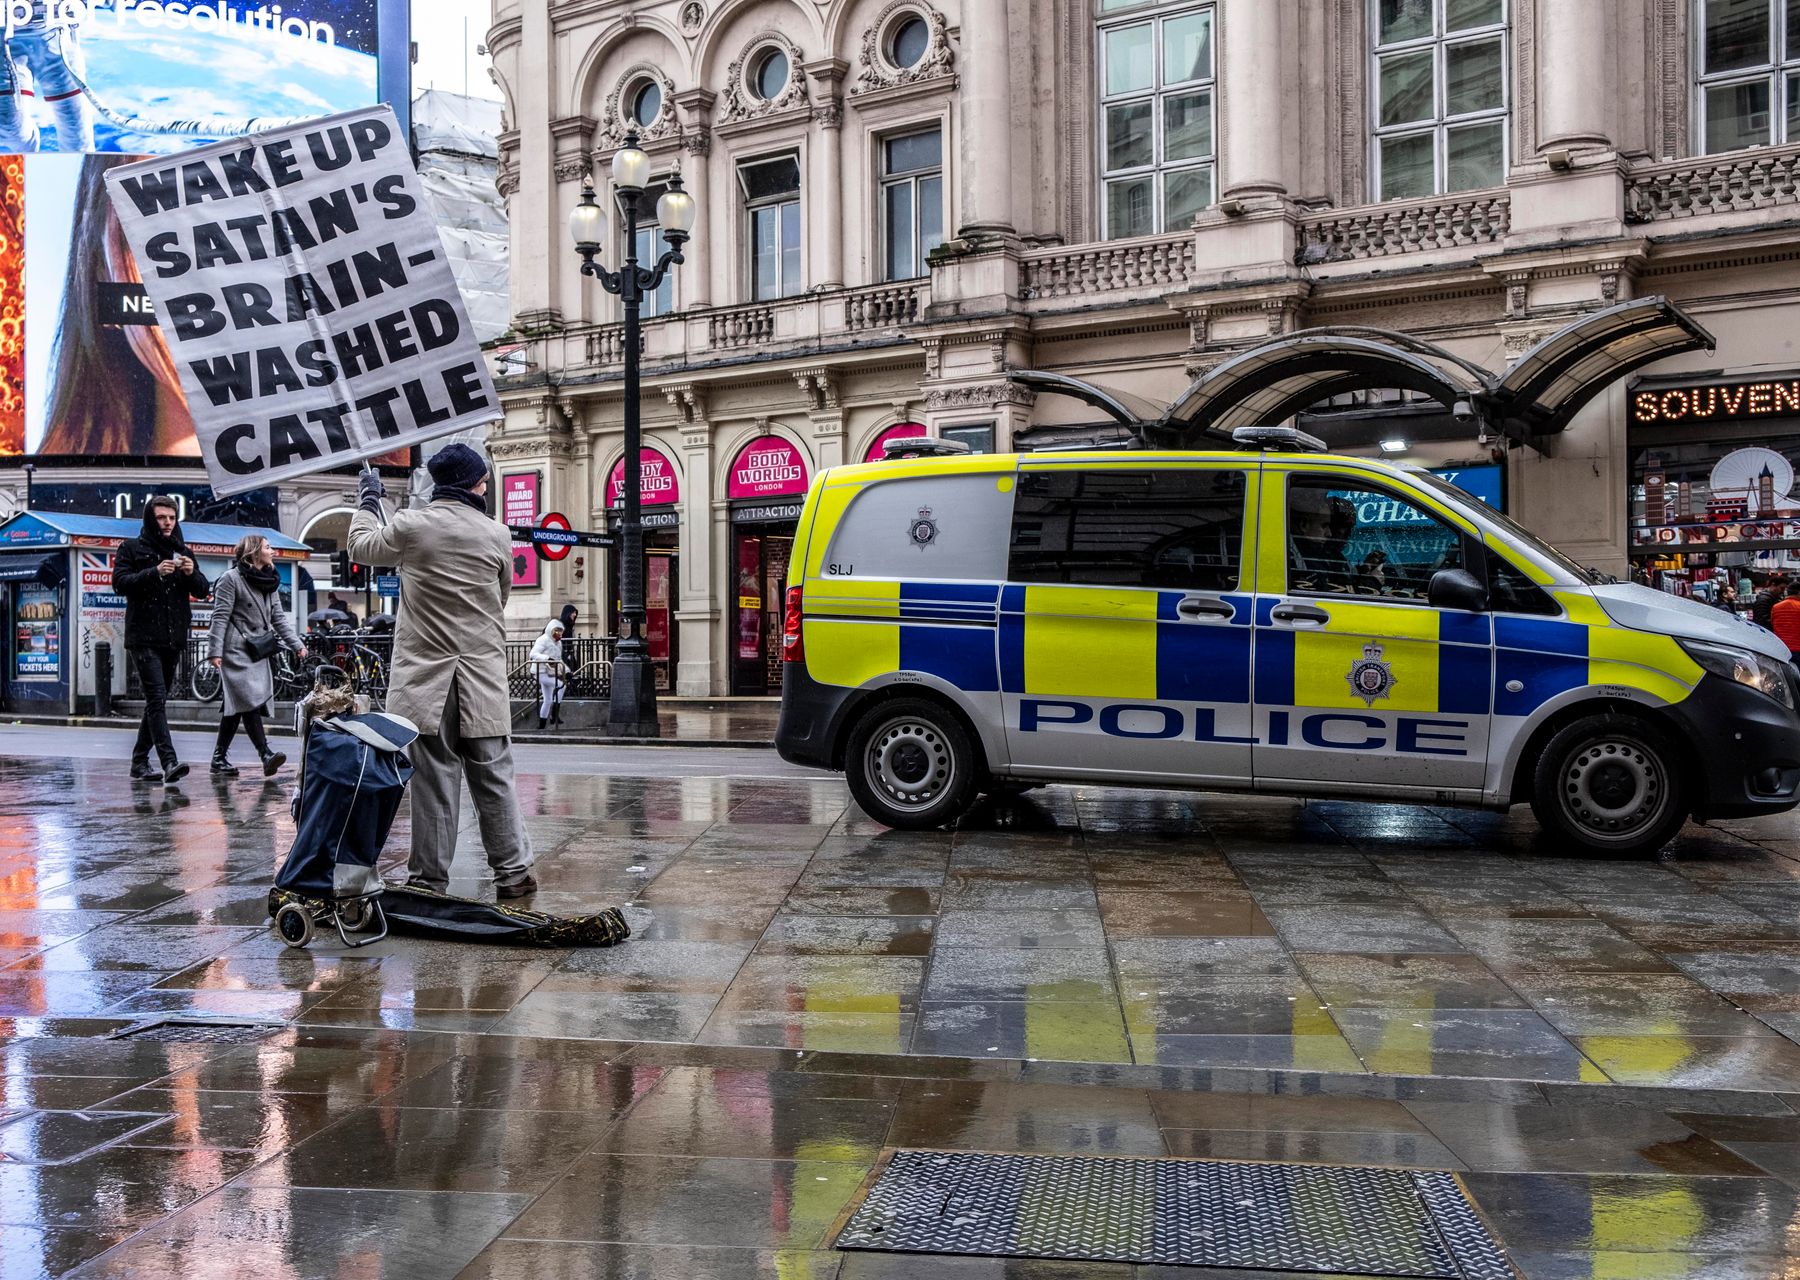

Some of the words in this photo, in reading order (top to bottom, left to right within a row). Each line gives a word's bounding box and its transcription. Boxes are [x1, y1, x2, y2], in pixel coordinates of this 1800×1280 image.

[117, 0, 334, 44] resolution
[120, 139, 303, 217] WAKE
[305, 119, 391, 172] UP
[145, 175, 416, 279] SATAN'S
[165, 242, 436, 342] BRAIN-
[189, 298, 460, 407] WASHED
[215, 362, 489, 475] CATTLE
[748, 451, 791, 468] BODY
[737, 466, 800, 484] WORLDS
[514, 481, 526, 489] THE
[614, 476, 672, 494] WRLDS
[754, 483, 783, 491] LONDON
[507, 490, 533, 501] AWARD
[507, 501, 533, 510] WINNING
[517, 517, 534, 527] REAL
[533, 532, 577, 542] UNDERGROUND
[193, 544, 222, 553] LONDON
[829, 563, 853, 576] SLJ
[95, 596, 127, 605] TICKETS
[19, 663, 41, 672] TICKETS
[42, 663, 58, 672] HERE
[1018, 699, 1469, 756] POLICE
